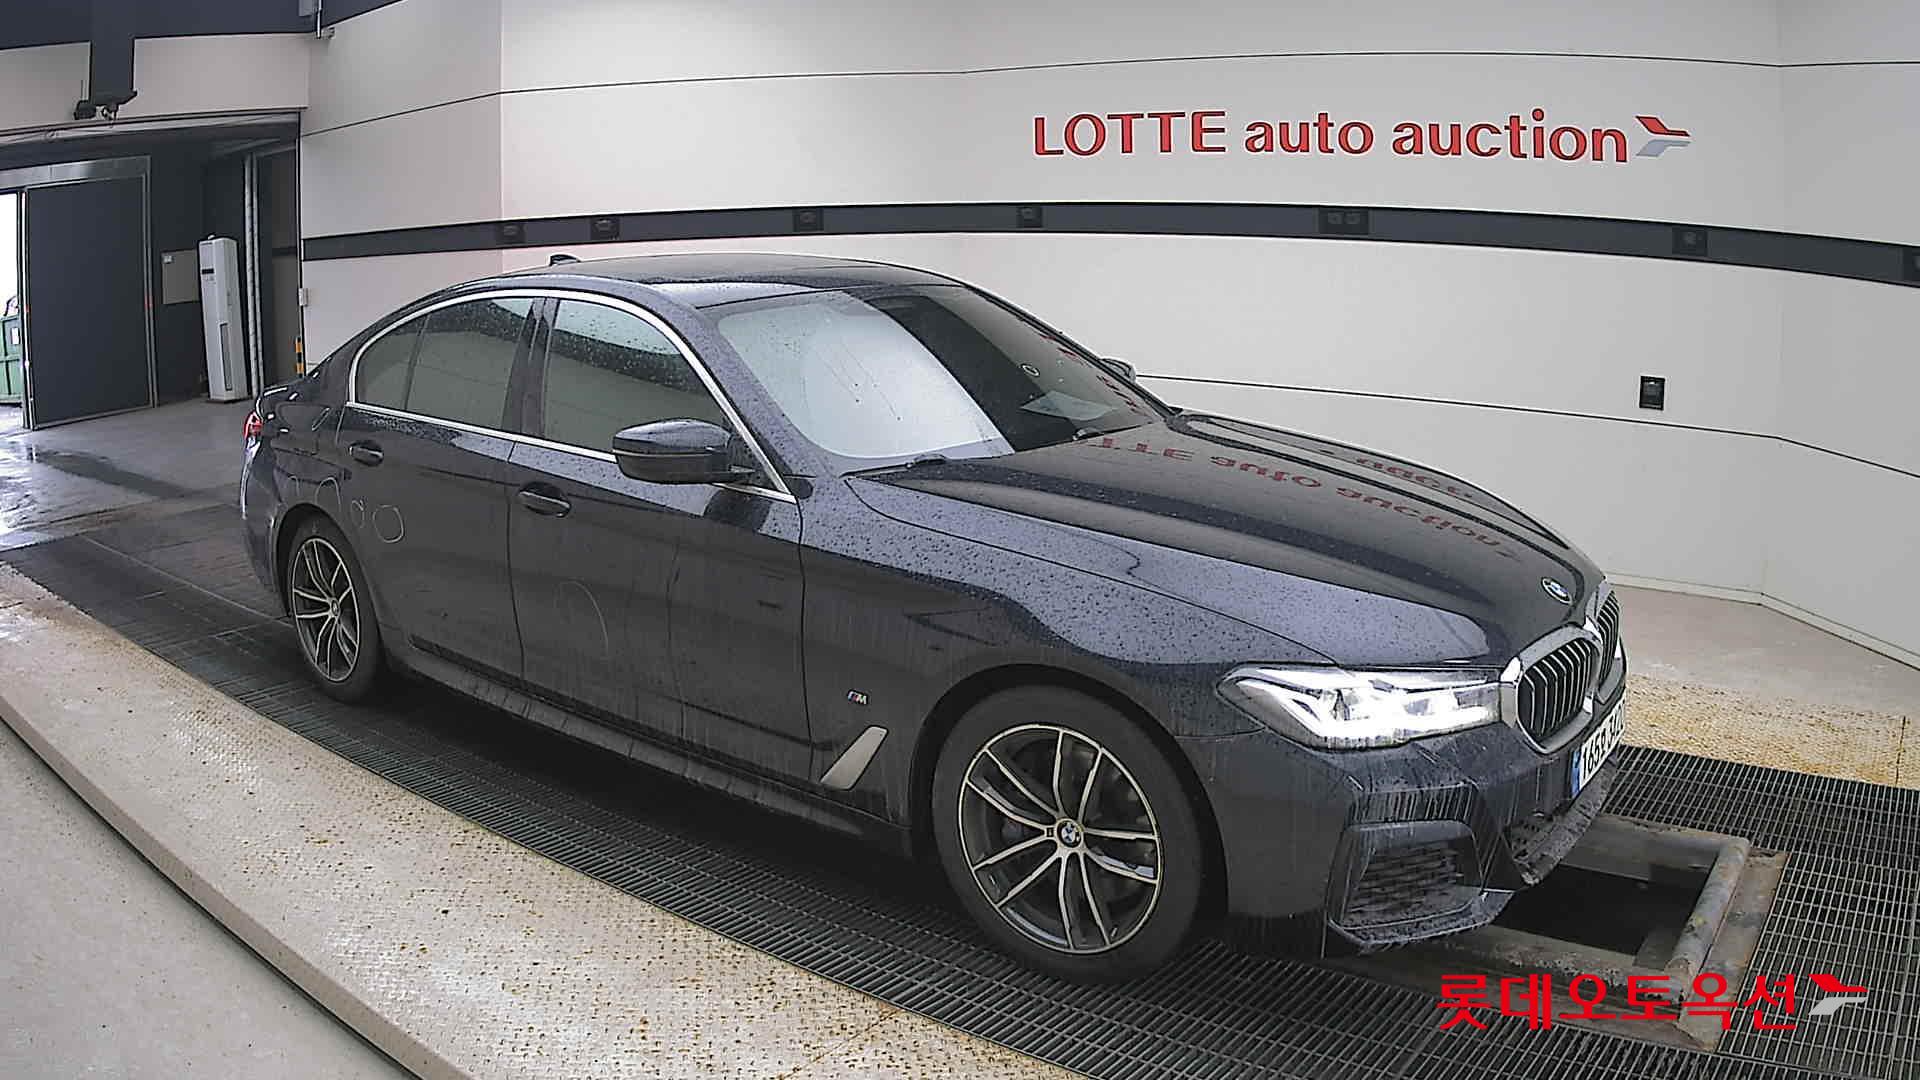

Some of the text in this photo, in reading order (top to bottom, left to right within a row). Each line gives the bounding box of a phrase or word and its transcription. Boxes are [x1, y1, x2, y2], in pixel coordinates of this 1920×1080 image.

[1034, 108, 1628, 162] LOTTE auto auction
